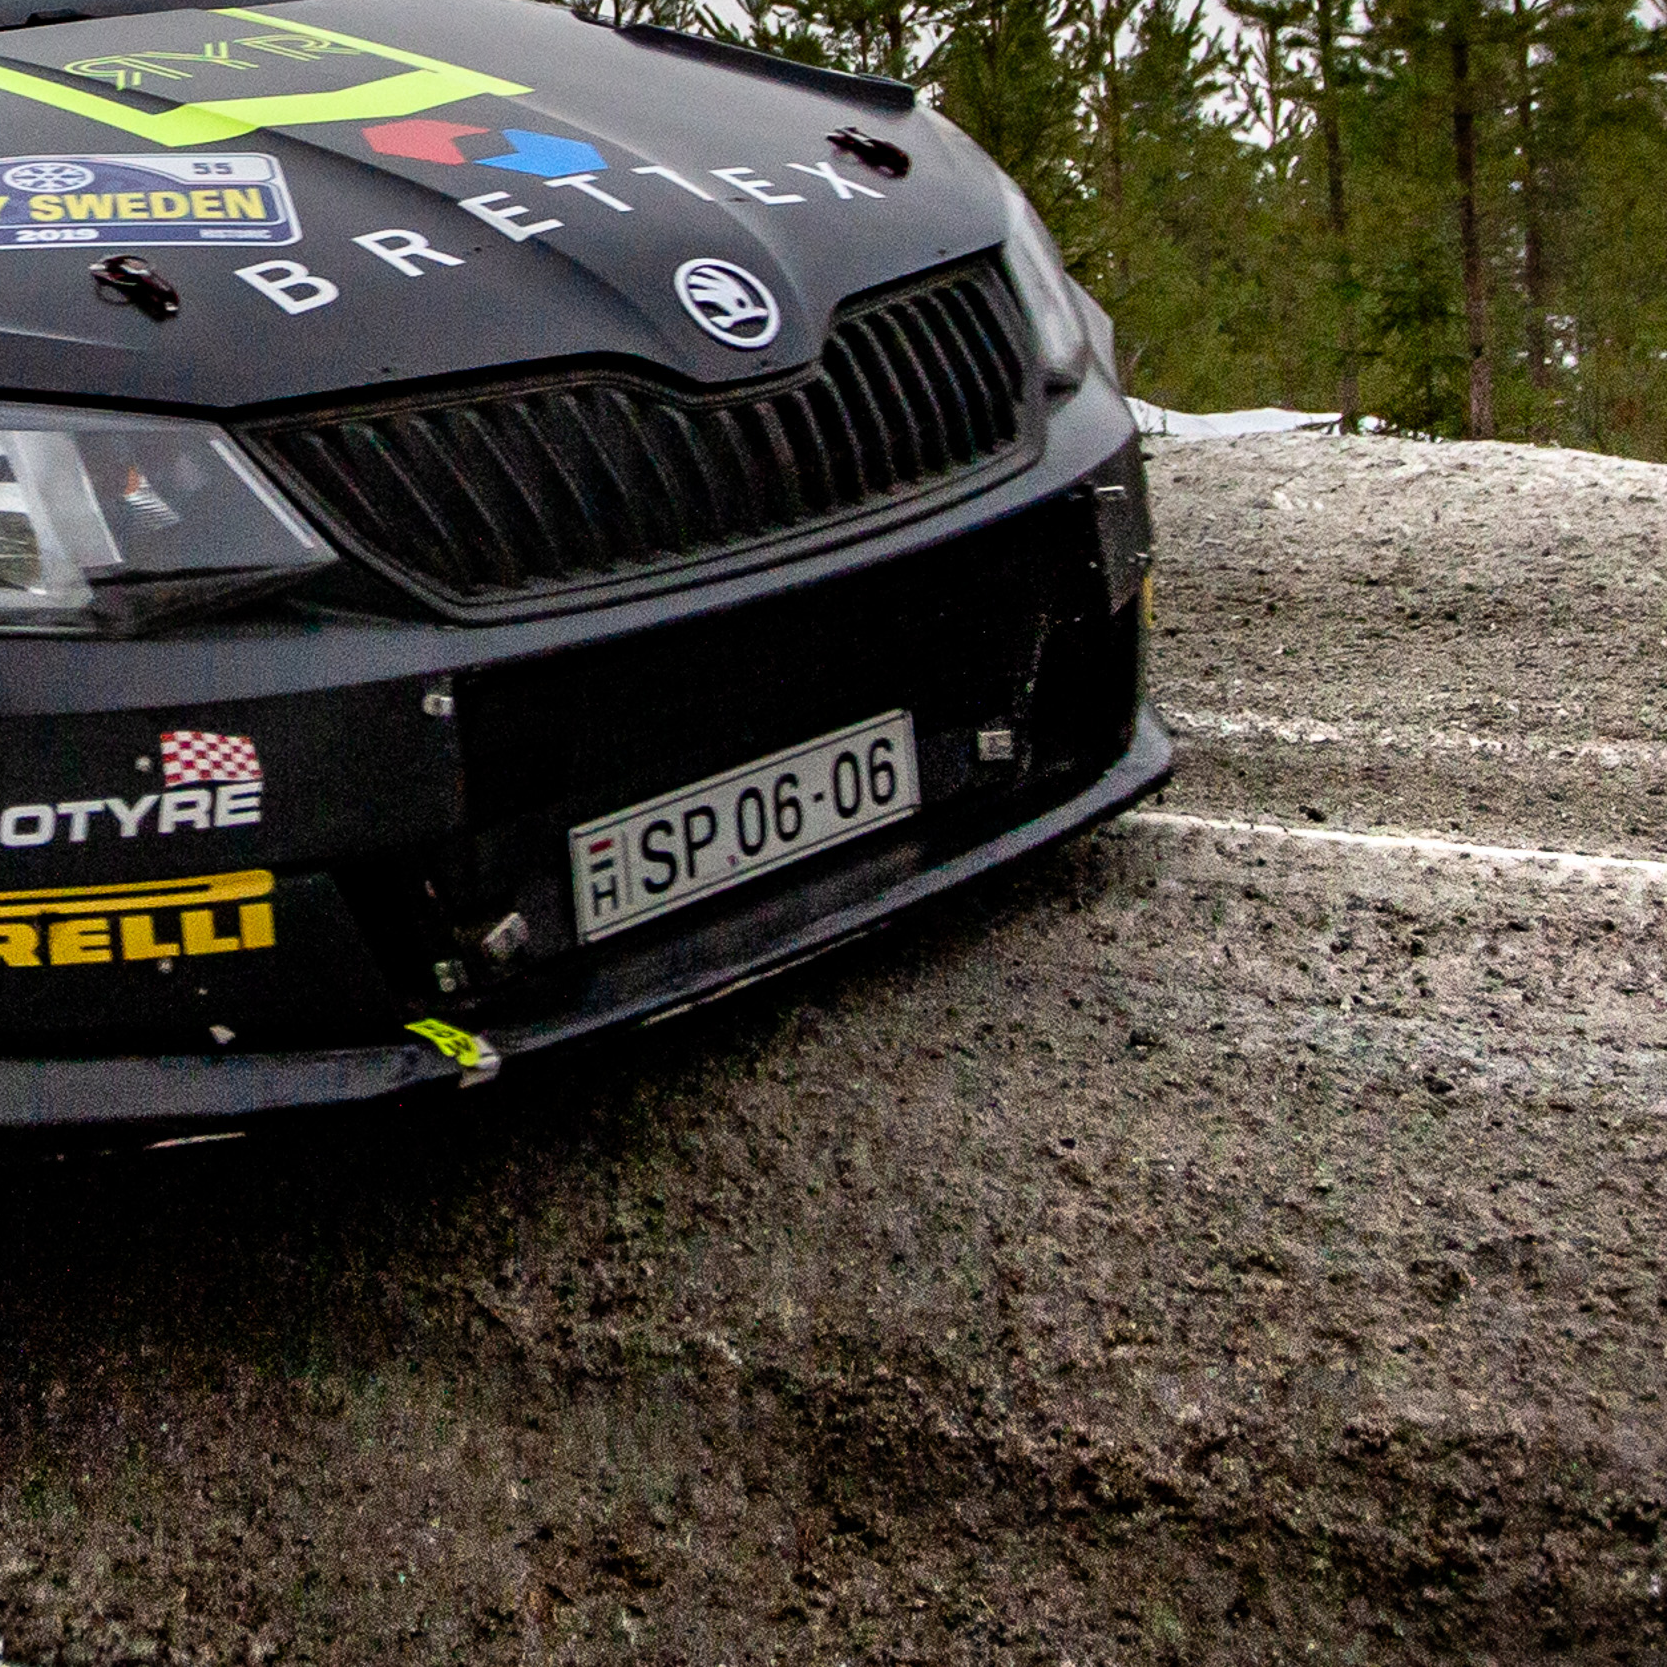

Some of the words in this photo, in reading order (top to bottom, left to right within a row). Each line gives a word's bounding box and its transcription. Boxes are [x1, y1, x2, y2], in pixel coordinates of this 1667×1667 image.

[192, 162, 234, 176] 55
[28, 188, 268, 222] SWEDEN
[15, 228, 100, 243] 2019
[234, 159, 887, 317] BRETTEX
[640, 819, 718, 895] SP
[736, 737, 896, 857] 06-06
[591, 874, 618, 917] H
